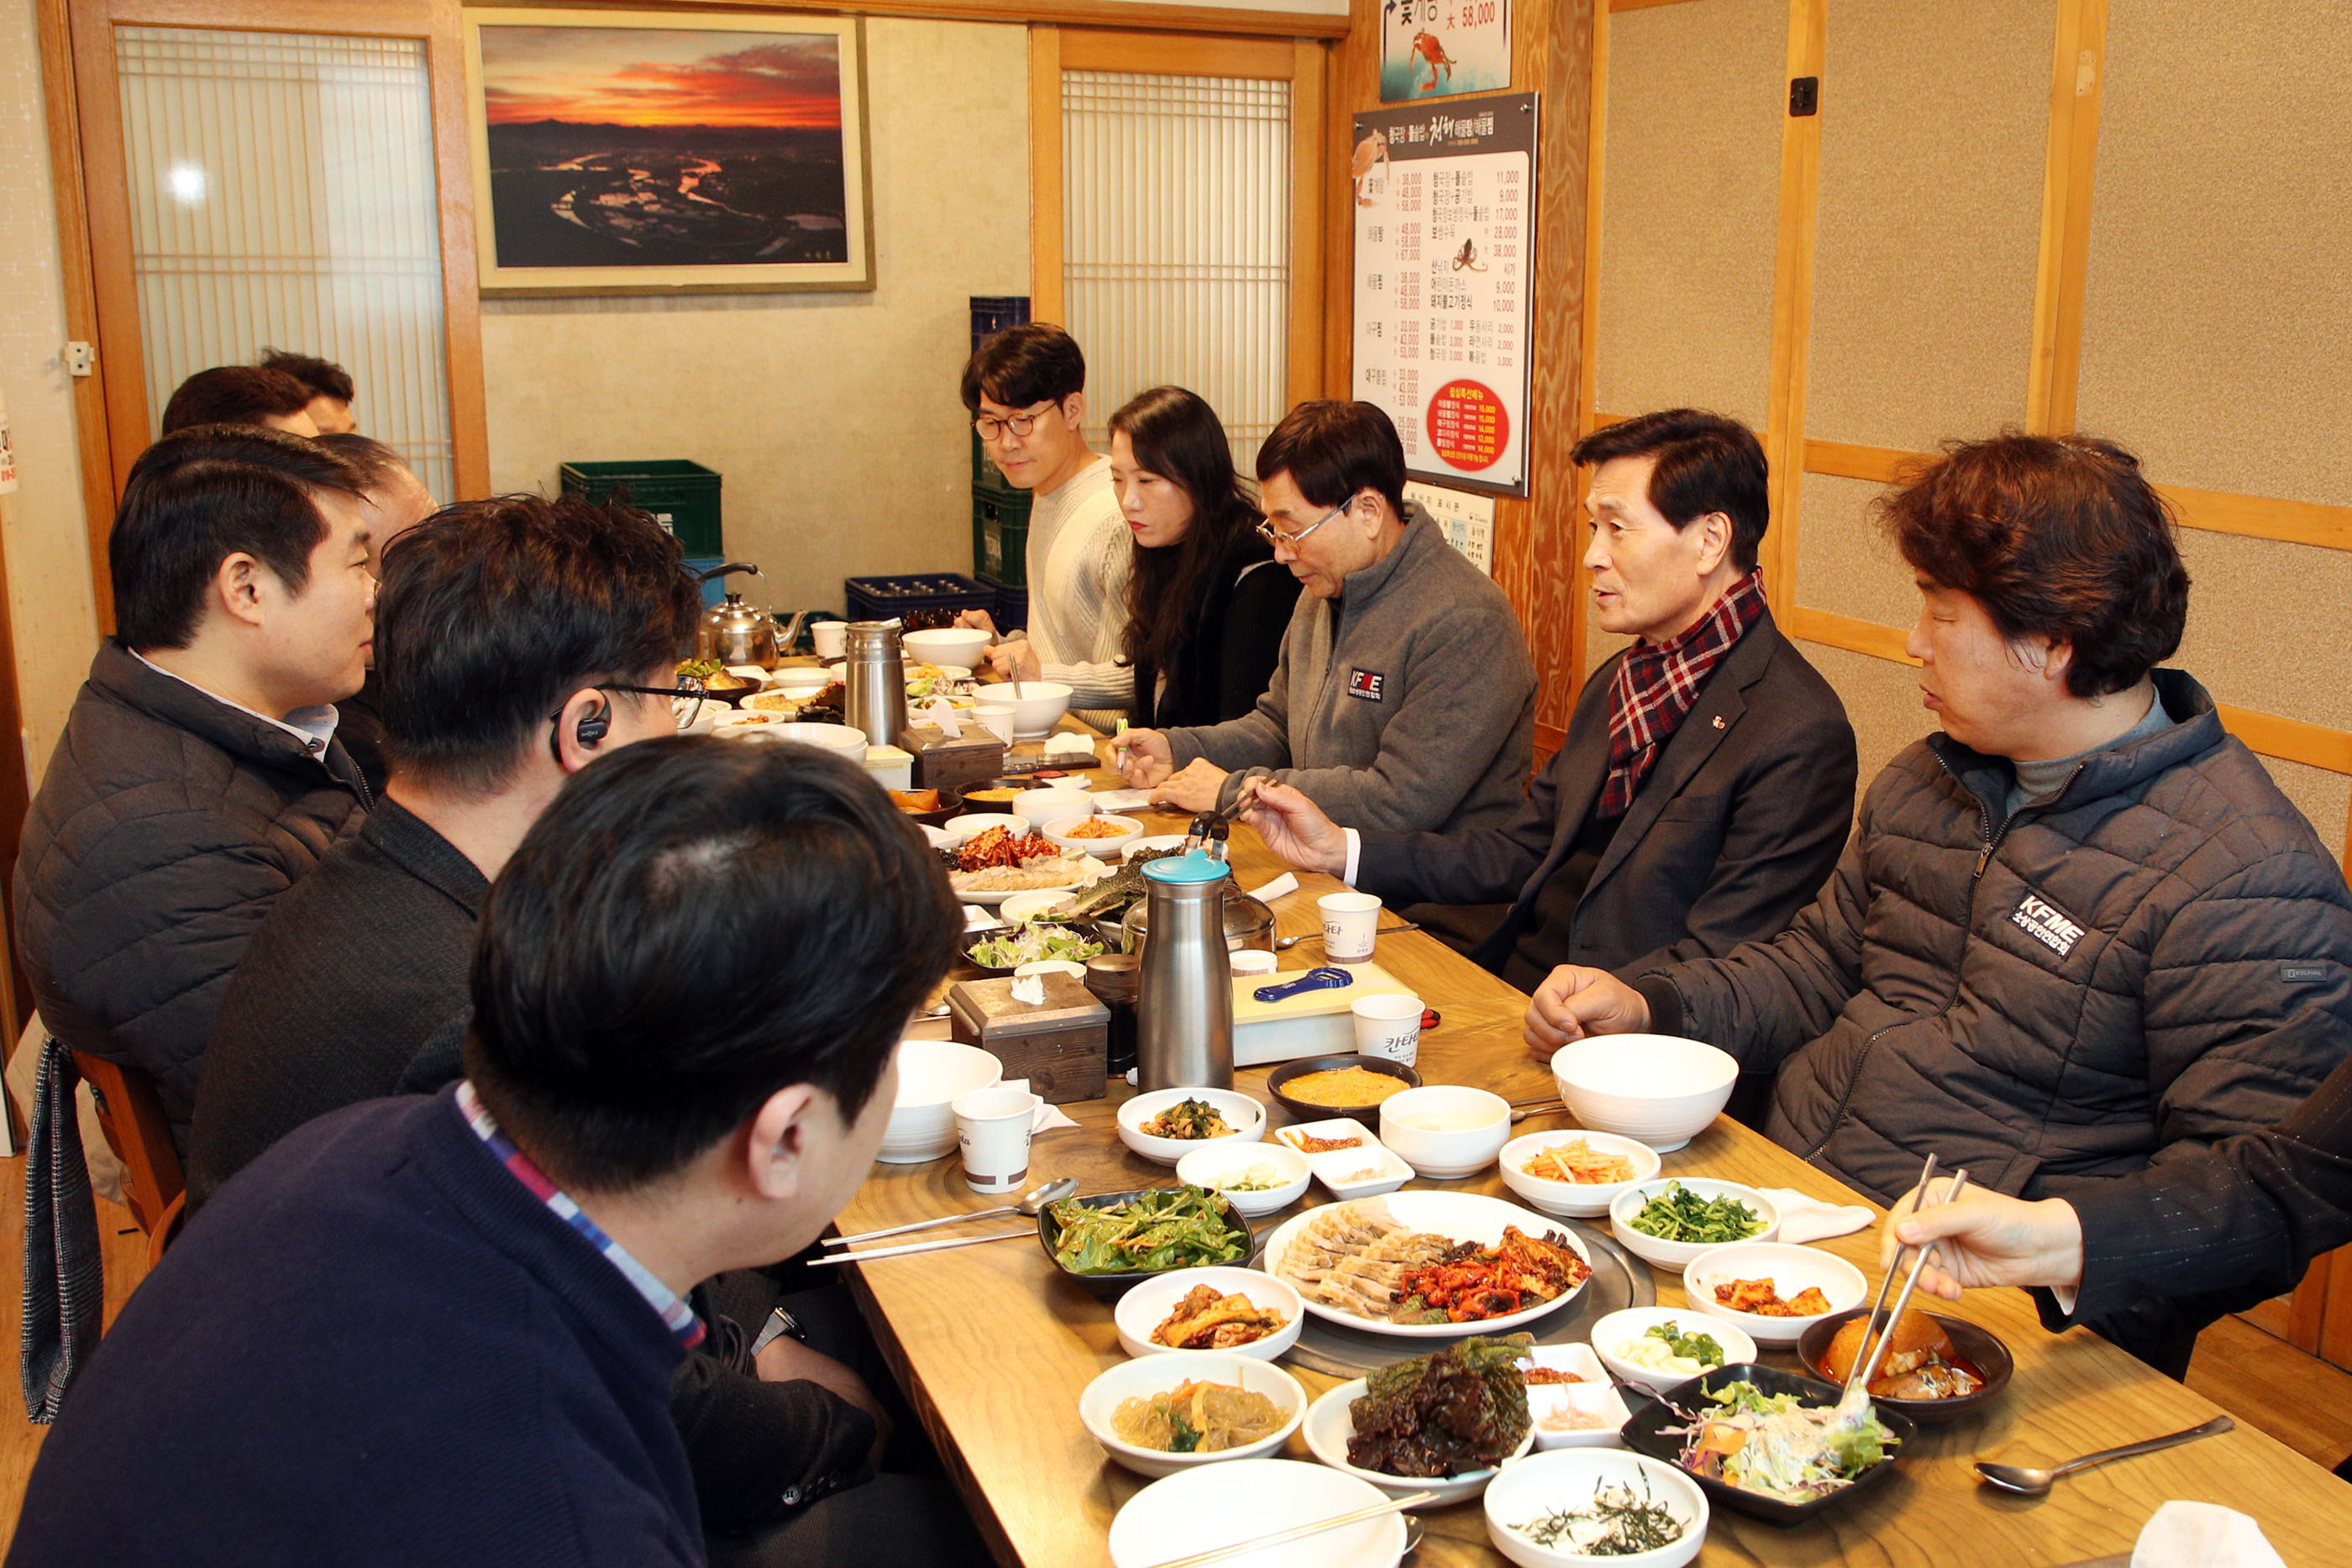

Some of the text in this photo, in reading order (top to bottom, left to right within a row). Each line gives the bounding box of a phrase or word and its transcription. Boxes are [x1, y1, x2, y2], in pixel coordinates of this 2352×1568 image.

[1462, 1, 1495, 29] 58,000
[1402, 173, 1422, 185] 38,000
[1497, 170, 1520, 185] 11,000
[1402, 186, 1422, 198] 48,000
[1499, 189, 1519, 202] 9,000
[1402, 199, 1422, 211] 58,000
[1496, 207, 1518, 221] 17,000
[1401, 223, 1421, 234] 48,000
[1494, 226, 1517, 239] 28,000
[1401, 236, 1421, 248] 58,000
[1401, 249, 1421, 261] 67,000
[1494, 244, 1517, 258] 38,000
[1400, 272, 1420, 284] 38,000
[1400, 285, 1420, 296] 48,000
[1496, 281, 1515, 295] 9,000
[1400, 297, 1420, 310] 58,000
[1494, 299, 1515, 312] 10,000
[1400, 320, 1420, 333] 33,000
[1451, 320, 1463, 331] 1,000
[1499, 323, 1515, 334] 2,000
[1400, 333, 1420, 345] 43,000
[1498, 339, 1514, 350] 2,000
[1478, 405, 1496, 414] 15,000
[1401, 443, 1417, 455] ,000
[2019, 895, 2086, 944] KFME
[1323, 923, 1343, 936] 타타
[2013, 911, 2071, 956] 소상공인연합회
